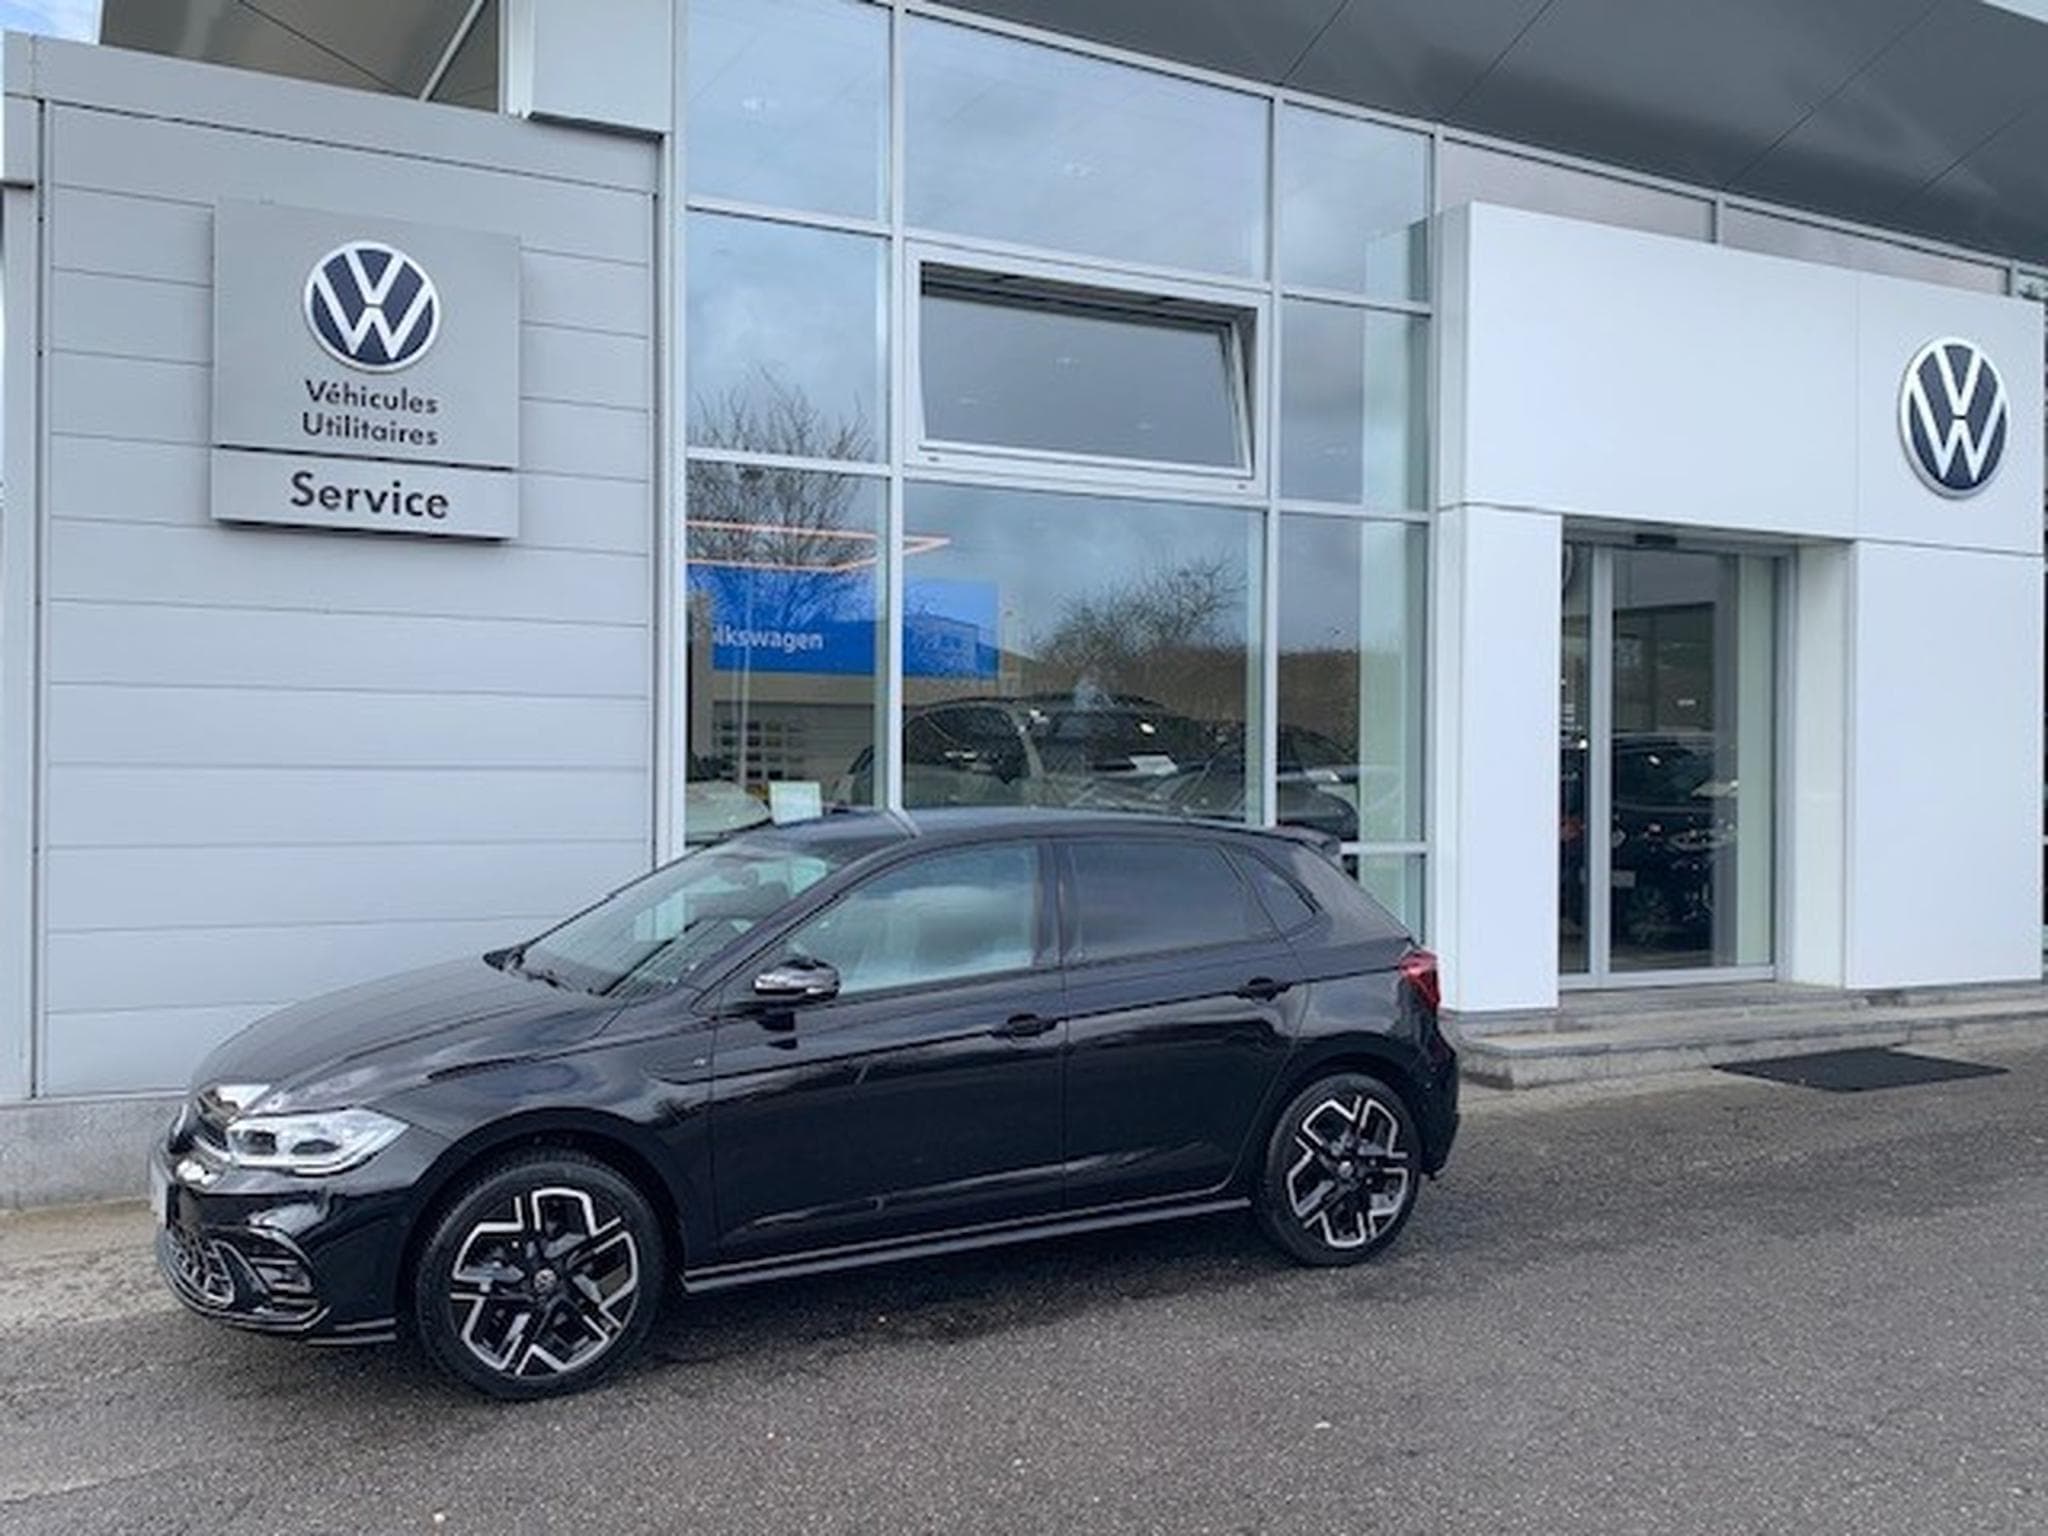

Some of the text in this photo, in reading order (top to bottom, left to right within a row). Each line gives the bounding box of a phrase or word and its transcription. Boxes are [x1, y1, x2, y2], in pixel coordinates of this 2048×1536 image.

[306, 243, 438, 370] VW
[305, 379, 438, 414] Véhicules
[1901, 340, 2008, 494] VW
[302, 411, 439, 446] Utilitaires
[290, 471, 449, 519] Service
[713, 623, 823, 654] lkswagen
